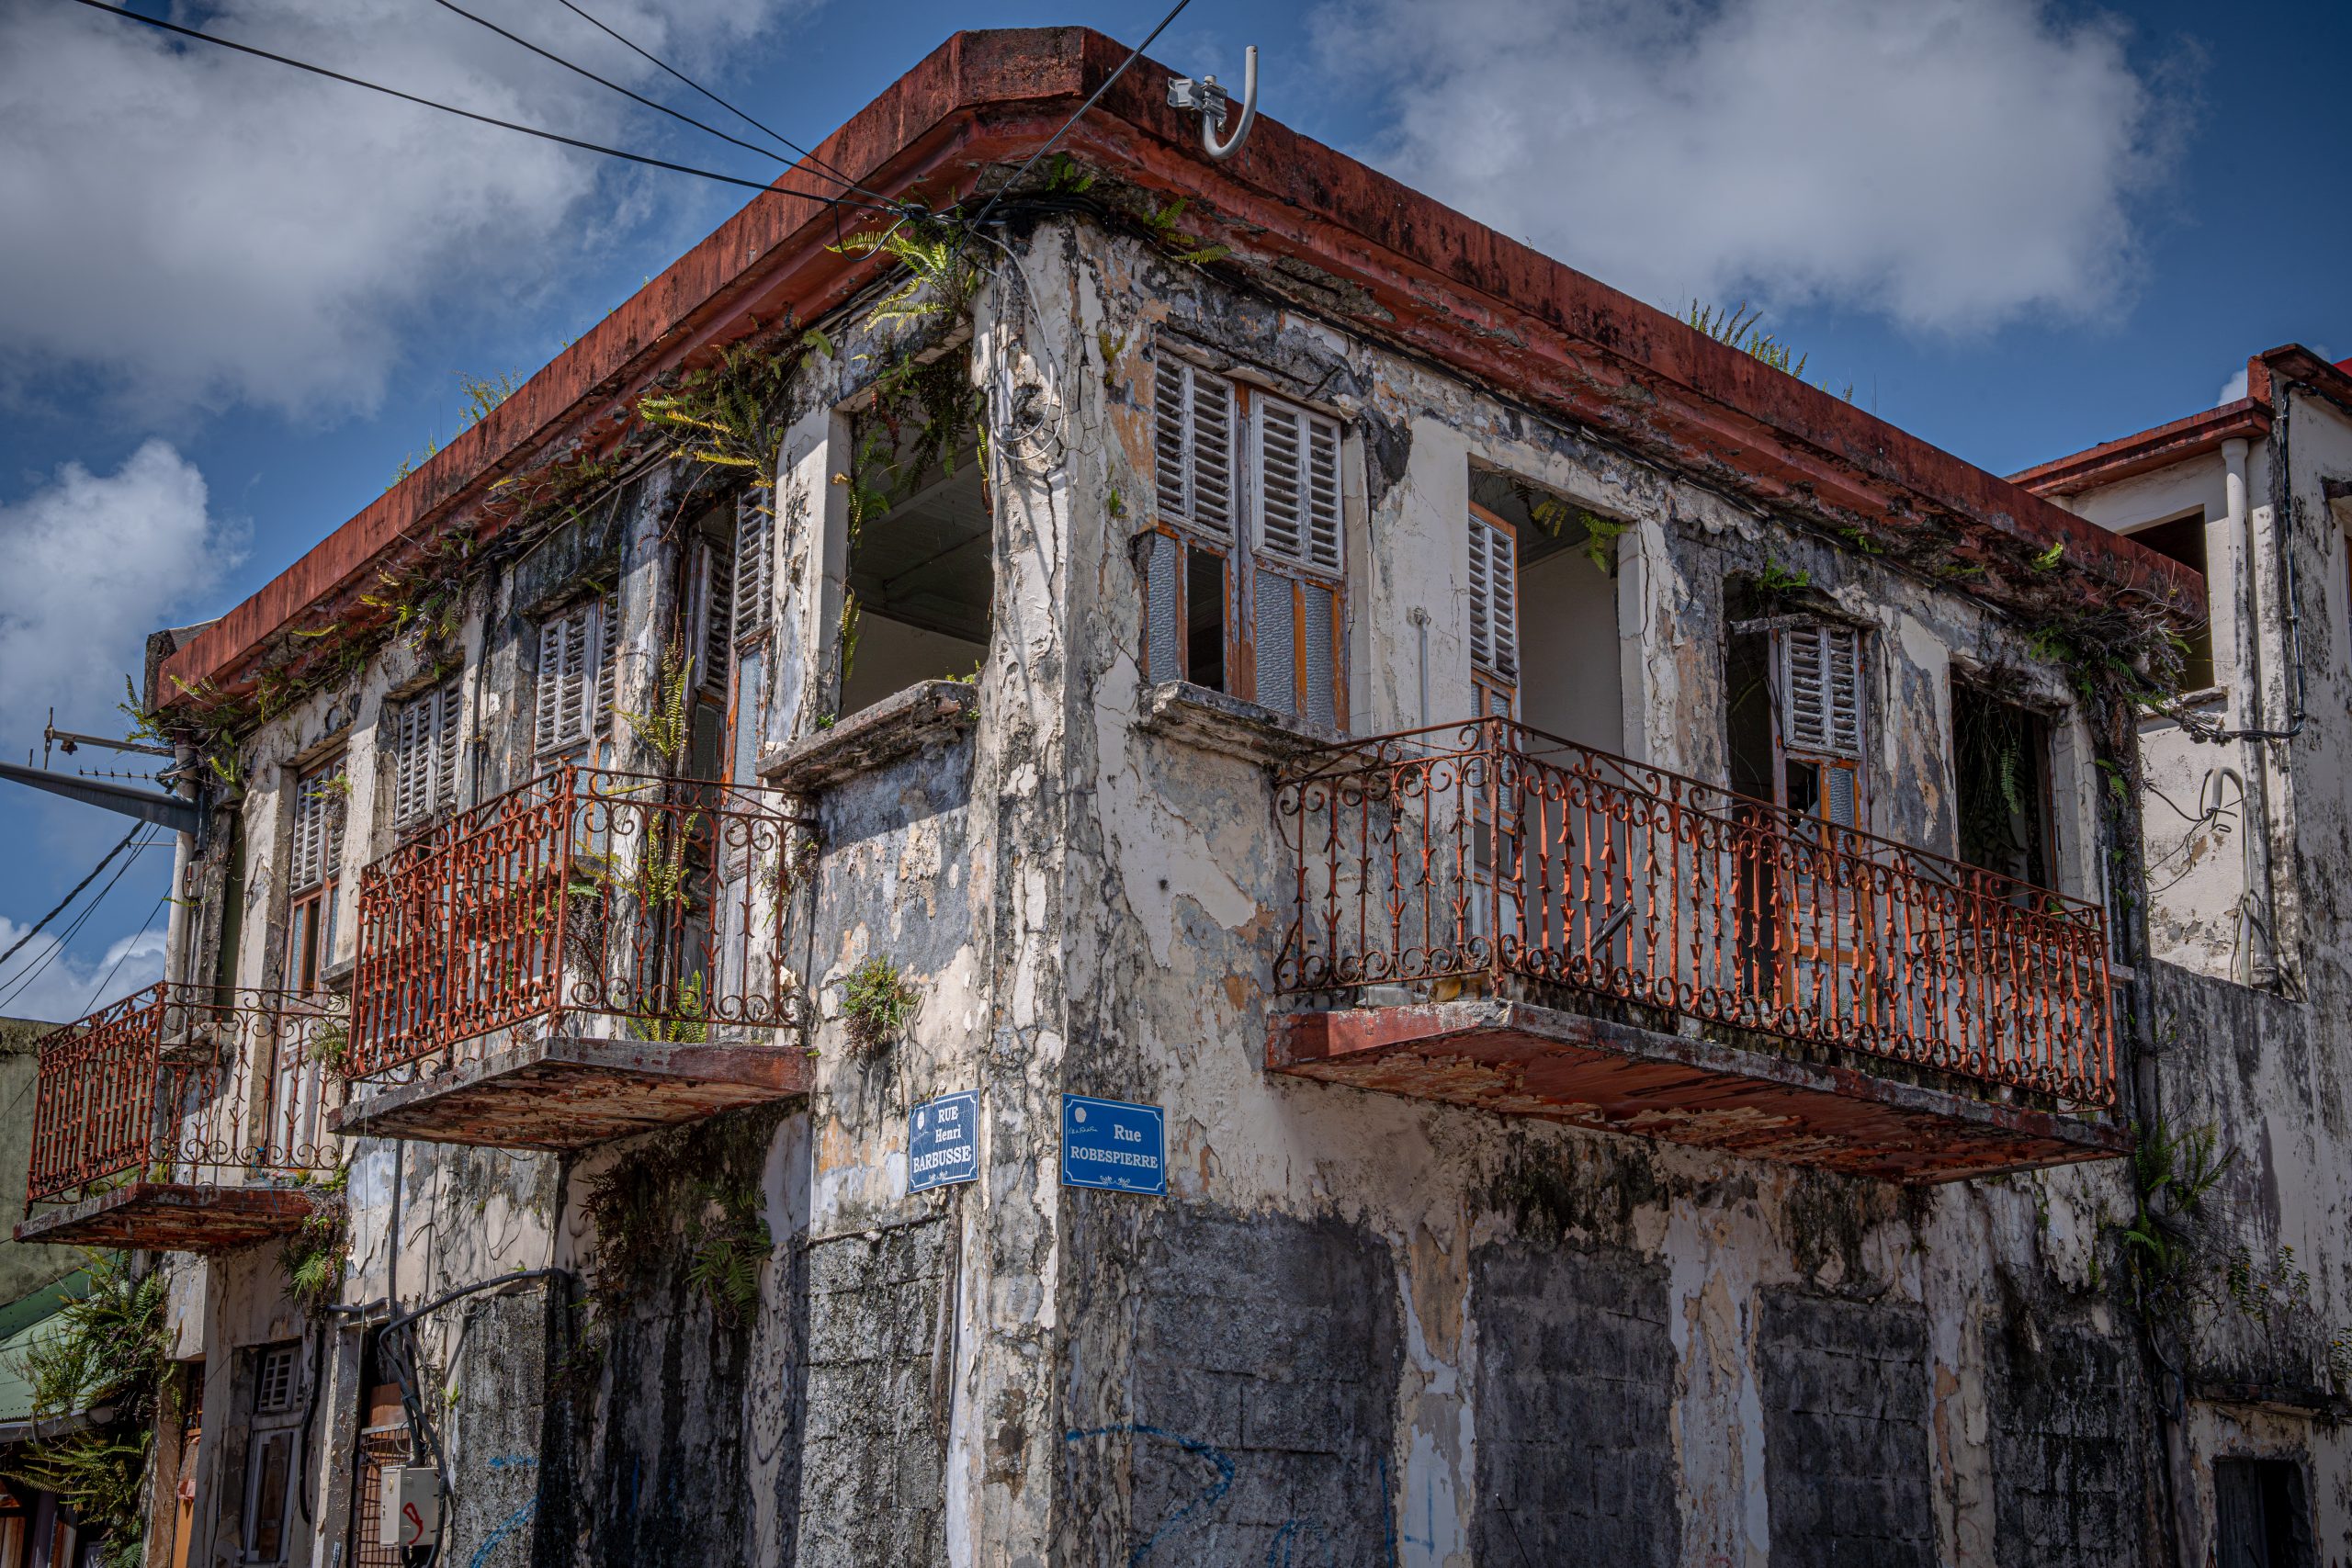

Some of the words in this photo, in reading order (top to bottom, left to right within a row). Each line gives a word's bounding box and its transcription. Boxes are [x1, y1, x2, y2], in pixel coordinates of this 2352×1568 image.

[937, 1106, 959, 1123] RUE
[934, 1124, 962, 1144] Henri
[1114, 1123, 1142, 1143] Rue
[912, 1145, 972, 1174] BARBUSSE
[1070, 1145, 1159, 1169] ROBESPIERRE
